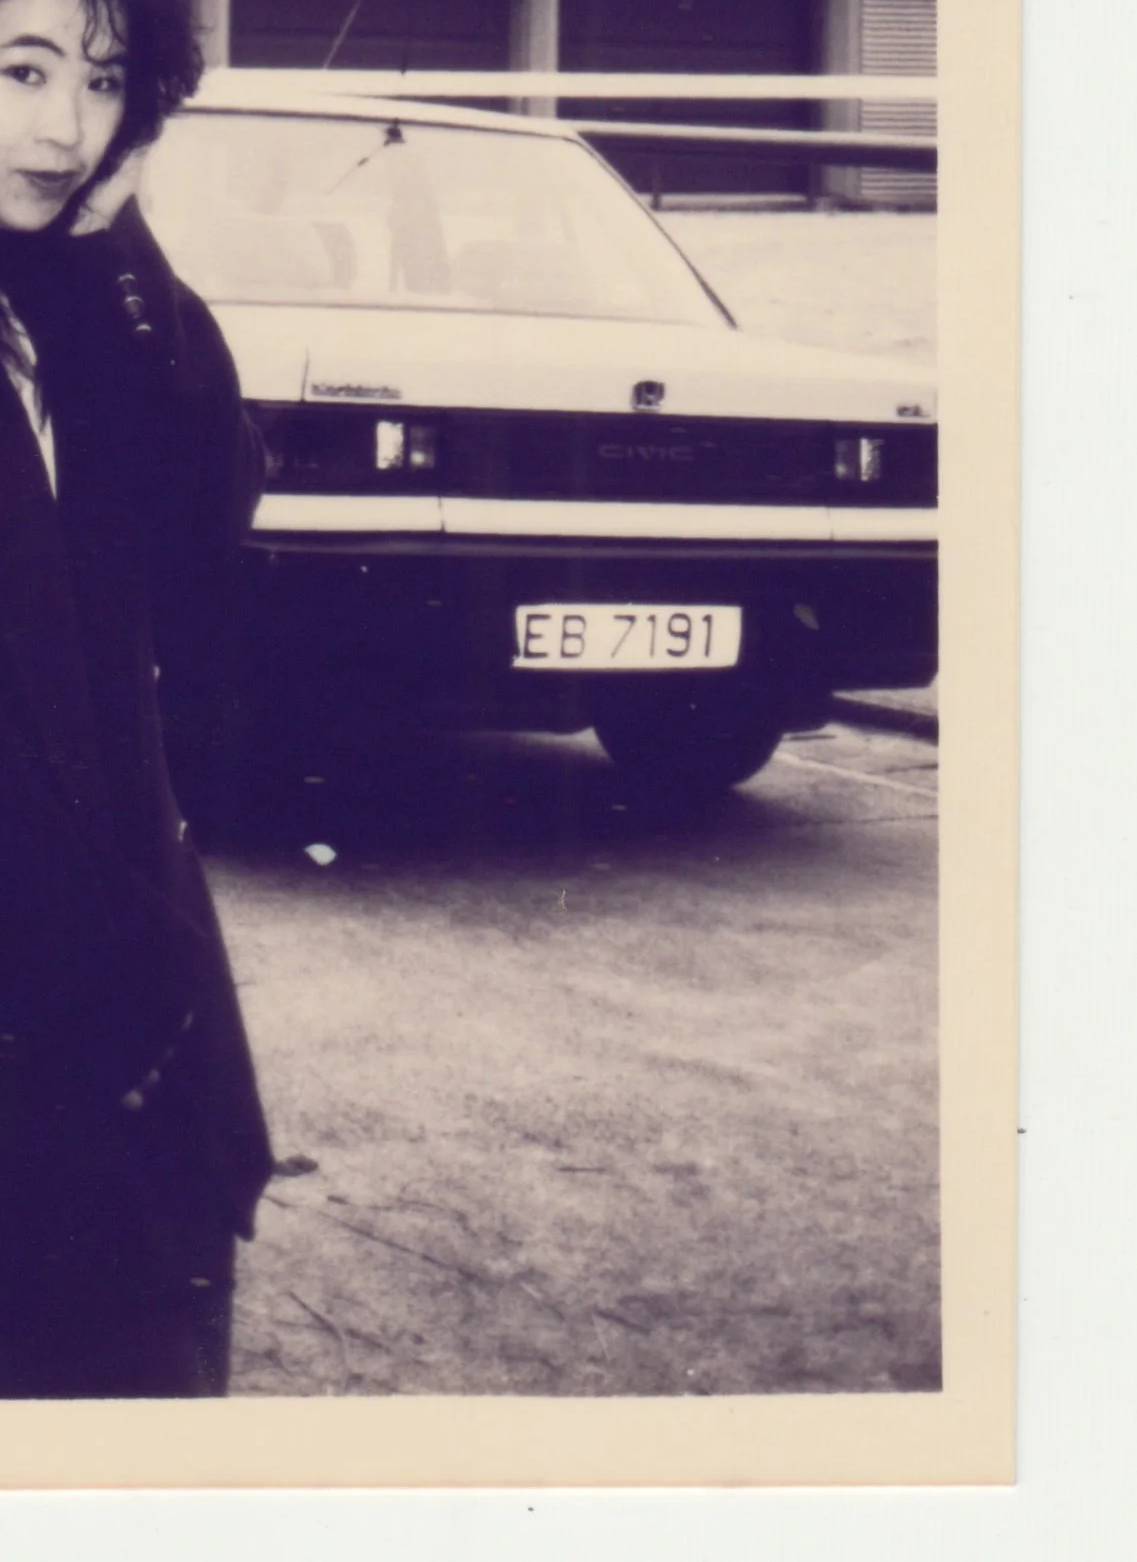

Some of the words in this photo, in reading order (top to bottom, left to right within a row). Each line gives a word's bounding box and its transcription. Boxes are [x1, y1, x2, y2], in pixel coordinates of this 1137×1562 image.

[597, 443, 694, 462] CIVIC
[522, 613, 587, 659] EB
[610, 612, 713, 658] 7191
